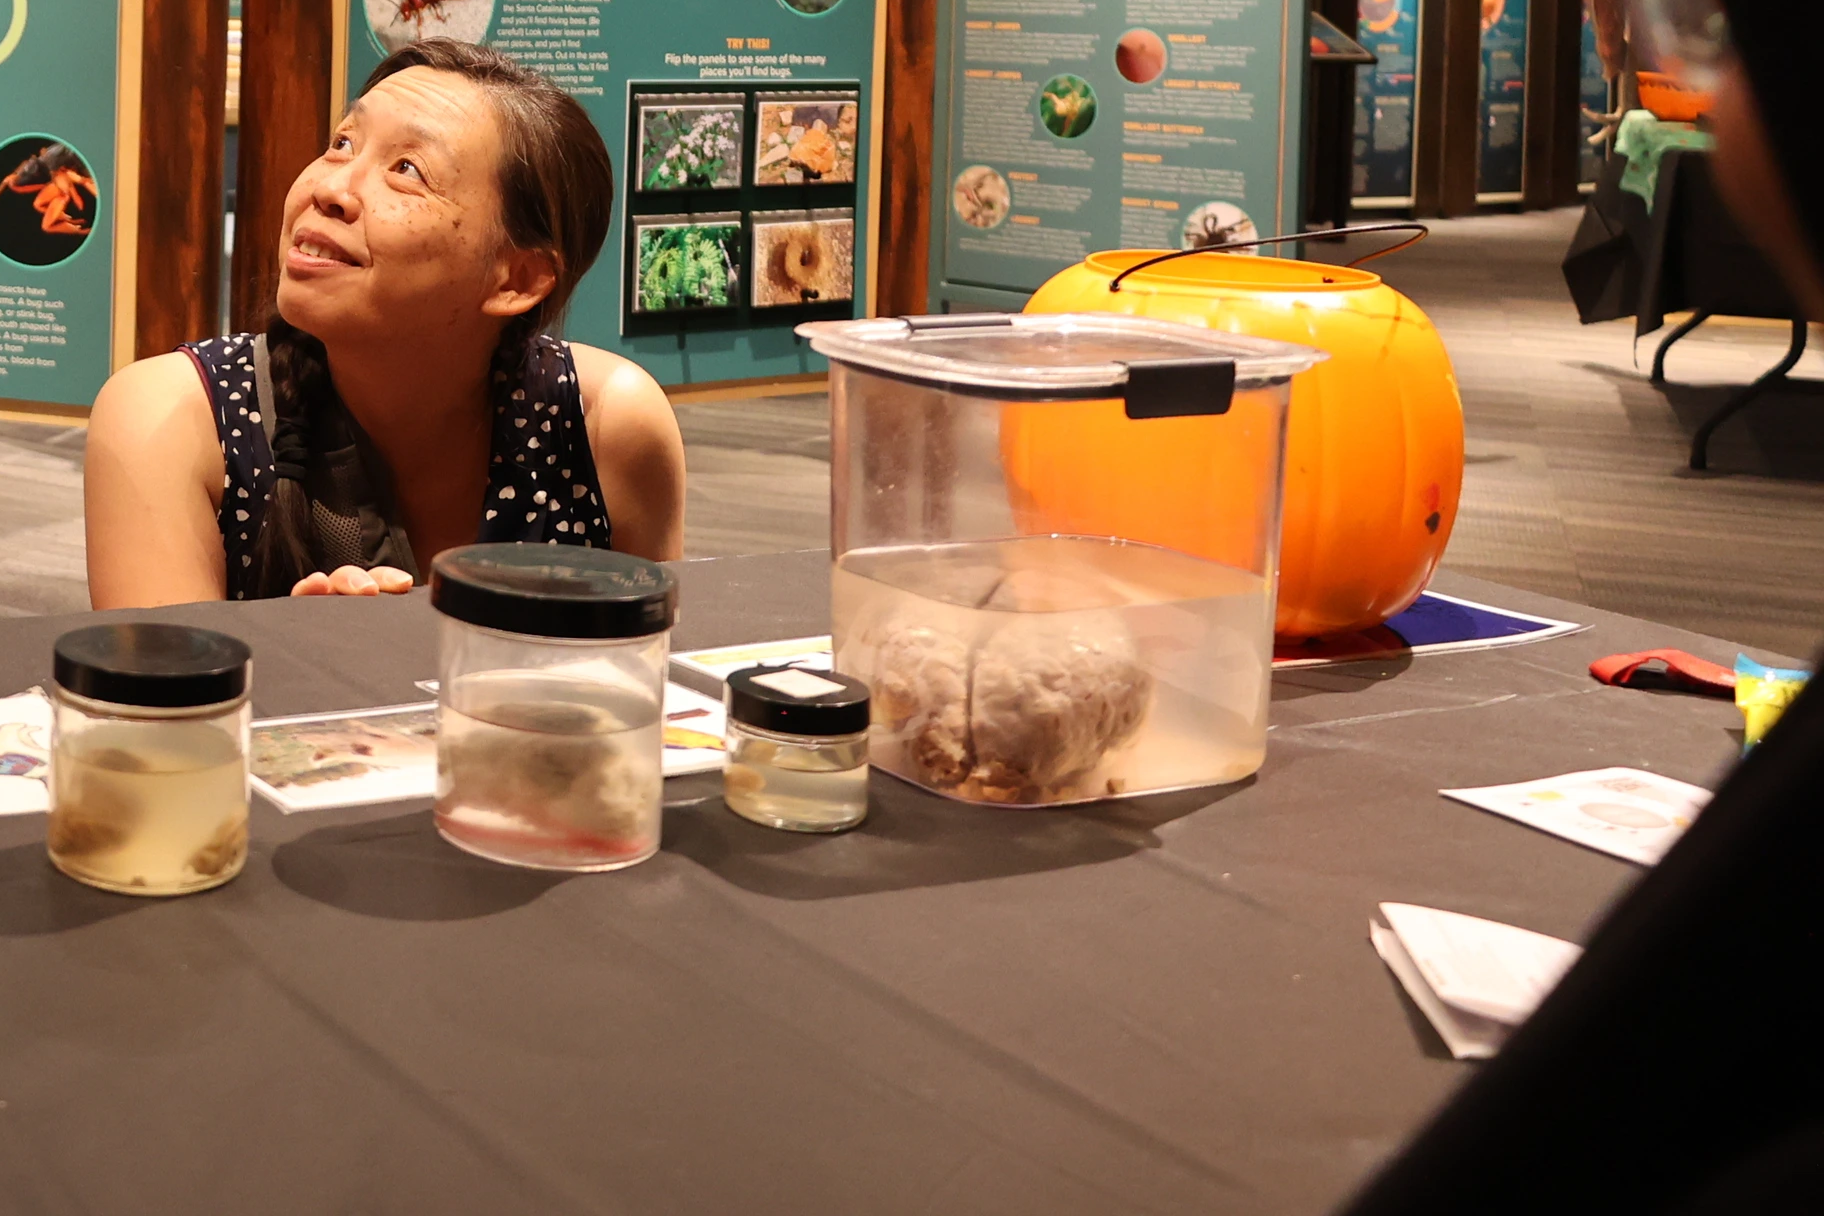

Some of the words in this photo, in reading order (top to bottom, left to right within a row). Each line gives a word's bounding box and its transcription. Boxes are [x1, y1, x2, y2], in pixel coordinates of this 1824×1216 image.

[726, 38, 744, 49] TRY
[747, 38, 770, 49] THIS!
[665, 53, 680, 66] Flip
[683, 54, 696, 64] the
[699, 54, 725, 66] panels
[728, 54, 736, 64] to
[738, 56, 753, 64] see
[755, 56, 777, 64] some
[779, 54, 787, 64] of
[789, 54, 802, 64] the
[804, 57, 826, 67] many
[700, 66, 726, 78] places
[753, 66, 768, 76] find
